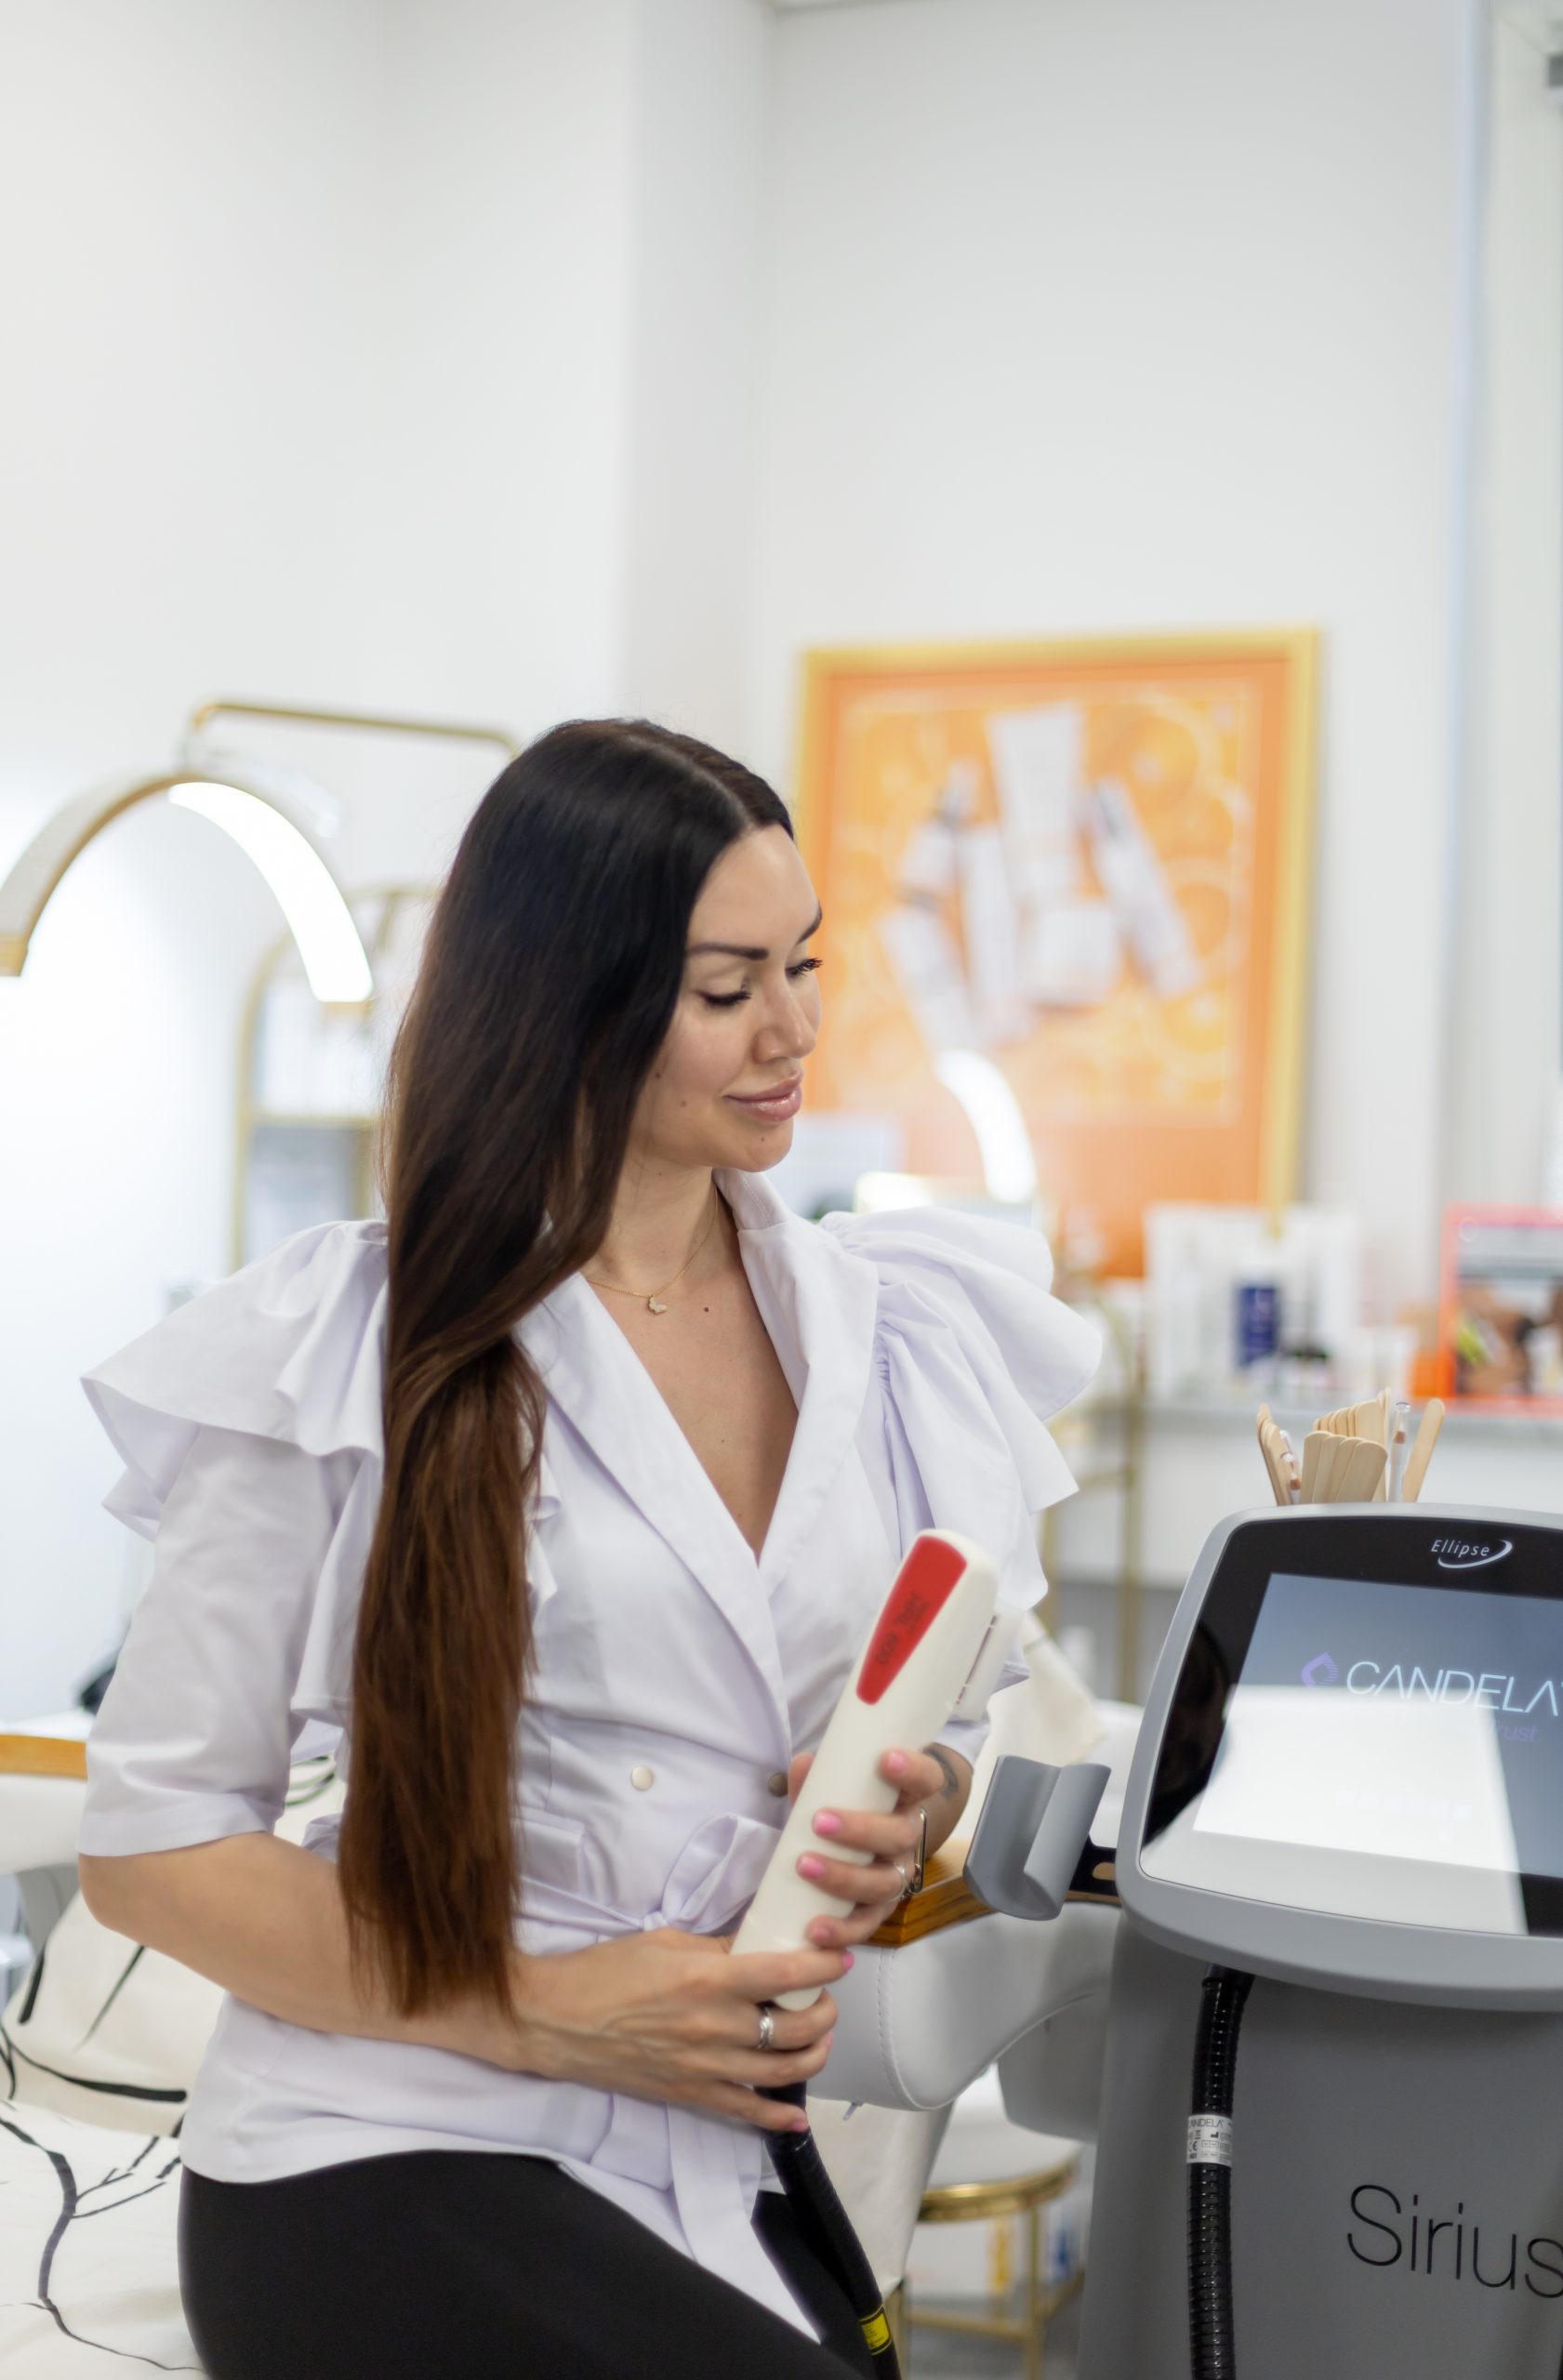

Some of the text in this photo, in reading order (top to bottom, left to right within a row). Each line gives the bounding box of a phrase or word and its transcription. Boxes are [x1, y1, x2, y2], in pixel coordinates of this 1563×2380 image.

[1430, 1539, 1490, 1559] Ellipse
[1345, 1659, 1559, 1717] CANDELA
[1346, 2184, 1563, 2299] Sirius
